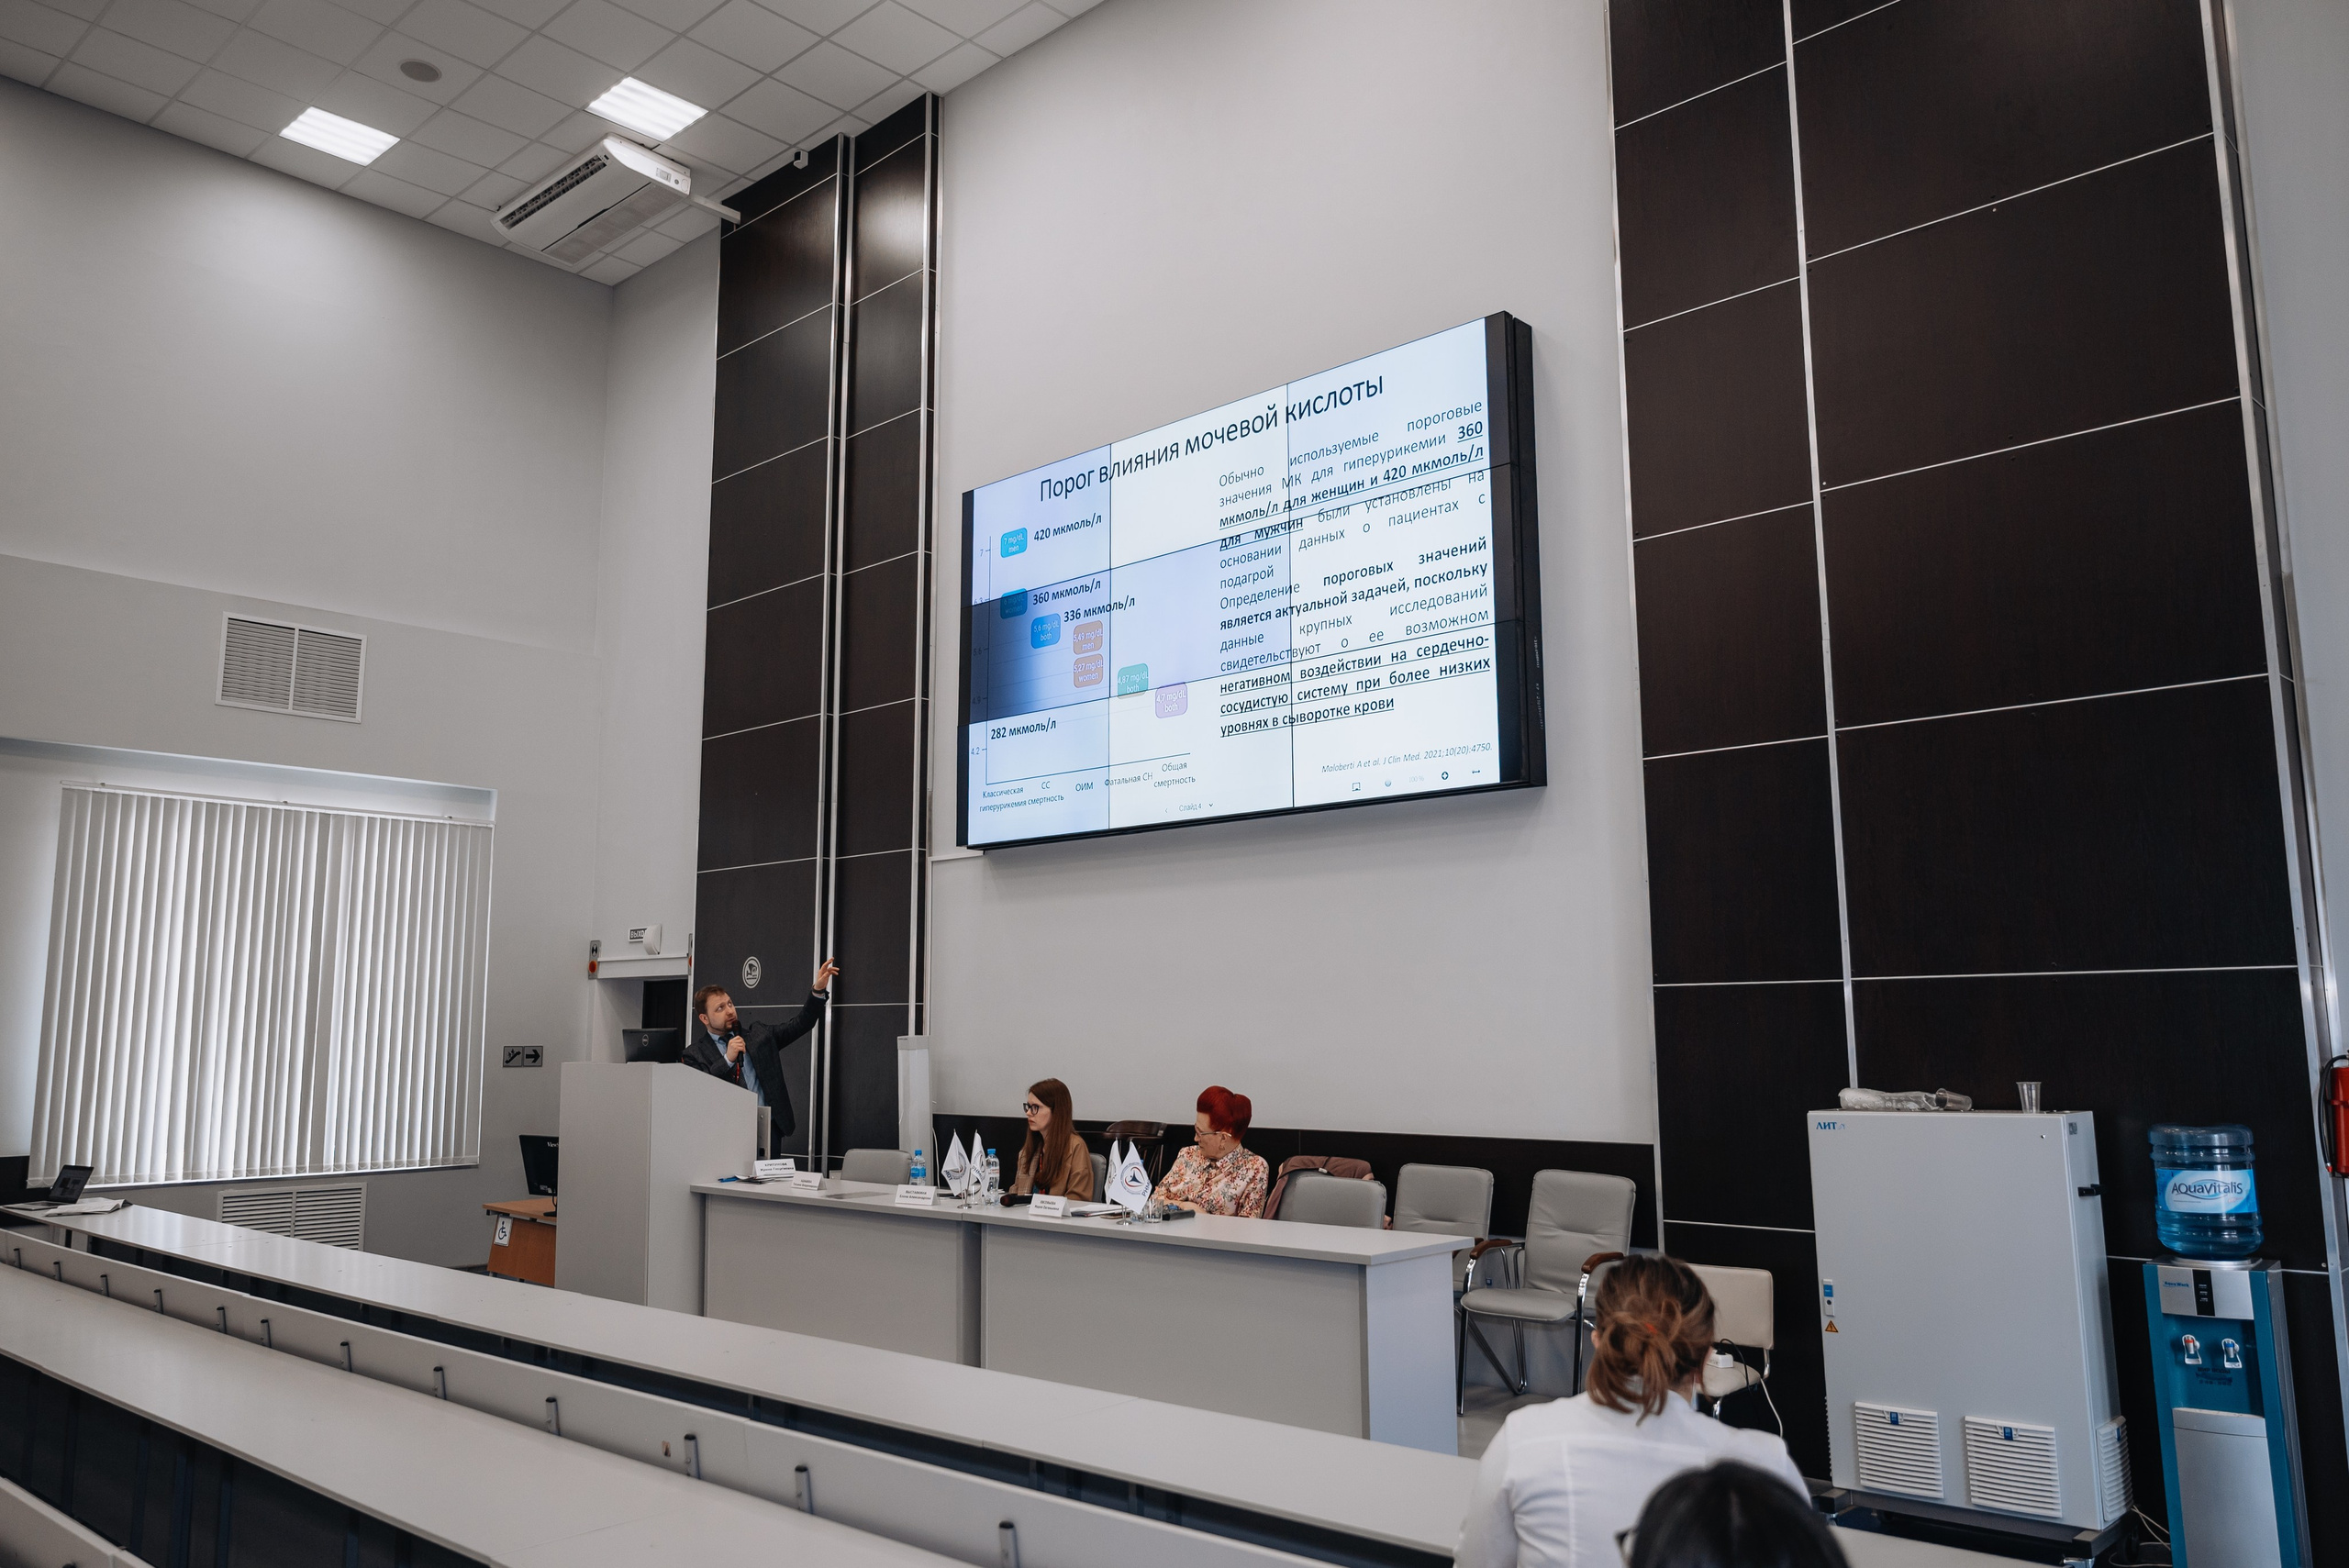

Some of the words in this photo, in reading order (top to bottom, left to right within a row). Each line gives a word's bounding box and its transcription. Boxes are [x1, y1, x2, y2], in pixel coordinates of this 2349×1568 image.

[1040, 466, 1095, 502] Порог
[1099, 442, 1179, 484] влияния
[1185, 404, 1278, 457] мочевой
[1286, 375, 1384, 424] кислоты
[1219, 465, 1264, 488] Обычно
[1289, 431, 1379, 468] используемые
[1407, 401, 1482, 433] пороговые
[1219, 482, 1272, 507] значения
[1282, 475, 1302, 489] МК
[1311, 466, 1333, 484] для
[1343, 435, 1447, 473] гиперурикемии
[1457, 420, 1483, 441] 360
[1219, 500, 1278, 528] мкмоль/л
[1284, 495, 1307, 512] для
[1311, 479, 1365, 503] женщин
[1370, 475, 1377, 487] и
[1383, 463, 1407, 482] 420
[1411, 444, 1484, 476] мкмоль/л
[1219, 534, 1241, 551] для
[1254, 517, 1303, 542] мужчин
[1318, 505, 1351, 524] были
[1364, 478, 1451, 514] установлены
[1468, 470, 1485, 484] на
[1034, 528, 1051, 542] 420
[1053, 513, 1102, 537] мкмоль/л
[1219, 544, 1282, 569] основании
[1298, 528, 1345, 552] данных
[1363, 522, 1370, 533] о
[1388, 499, 1459, 528] пациентах
[1478, 494, 1486, 505] с
[1004, 538, 1008, 546] 7
[1008, 545, 1019, 553] men
[1220, 583, 1300, 610] Определение
[1323, 562, 1394, 587] пороговых
[1418, 537, 1486, 565] значений
[1220, 565, 1274, 590] подагрой
[1032, 592, 1050, 606] 360
[1052, 578, 1101, 601] мкмоль/л
[1219, 611, 1272, 630] является
[1275, 589, 1348, 619] актуальной
[1351, 578, 1409, 603] задачей,
[1414, 562, 1487, 589] поскольку
[1063, 608, 1081, 623] 336
[1084, 595, 1135, 618] мкмоль/л
[1219, 633, 1264, 654] данные
[1299, 615, 1353, 636] крупных
[1390, 583, 1487, 617] исследований
[1040, 631, 1052, 641] both
[1082, 642, 1095, 651] men
[1220, 643, 1321, 672] свидетельствуют
[1341, 638, 1349, 649] о
[1369, 630, 1384, 644] ее
[1406, 609, 1489, 636] возможном
[1220, 672, 1291, 694] негативном
[1300, 653, 1382, 679] воздействии
[1390, 650, 1407, 662] на
[1416, 636, 1489, 659] сердечно-
[1078, 673, 1099, 684] women
[1126, 683, 1140, 694] both
[1220, 692, 1288, 715] сосудистую
[1297, 682, 1348, 703] систему
[1356, 677, 1381, 694] при
[1389, 666, 1430, 685] более
[1440, 657, 1491, 677] низких
[1164, 703, 1178, 713] both
[1220, 717, 1269, 739] уровнях
[1272, 717, 1279, 728] в
[1282, 704, 1351, 726] сыворотке
[1354, 697, 1394, 717] крови
[991, 726, 1007, 740] 282
[1009, 717, 1056, 737] мкмоль/л
[1162, 762, 1187, 773] Общая
[1321, 761, 1355, 773] Maloberti
[1356, 760, 1363, 768] A
[1364, 760, 1371, 768] et
[1373, 757, 1381, 766] al.
[1387, 754, 1401, 764] Clin
[1403, 751, 1421, 762] Med.
[1041, 781, 1051, 790] СС
[1075, 782, 1094, 792] ОИМ
[1104, 774, 1141, 787] Фатальная
[1142, 772, 1153, 782] СН
[1153, 776, 1197, 789] смертность
[983, 785, 1024, 799] Классическая
[1028, 795, 1064, 806] смертность
[979, 798, 1027, 813] гиперурикемия
[630, 929, 646, 939] ВЫХО
